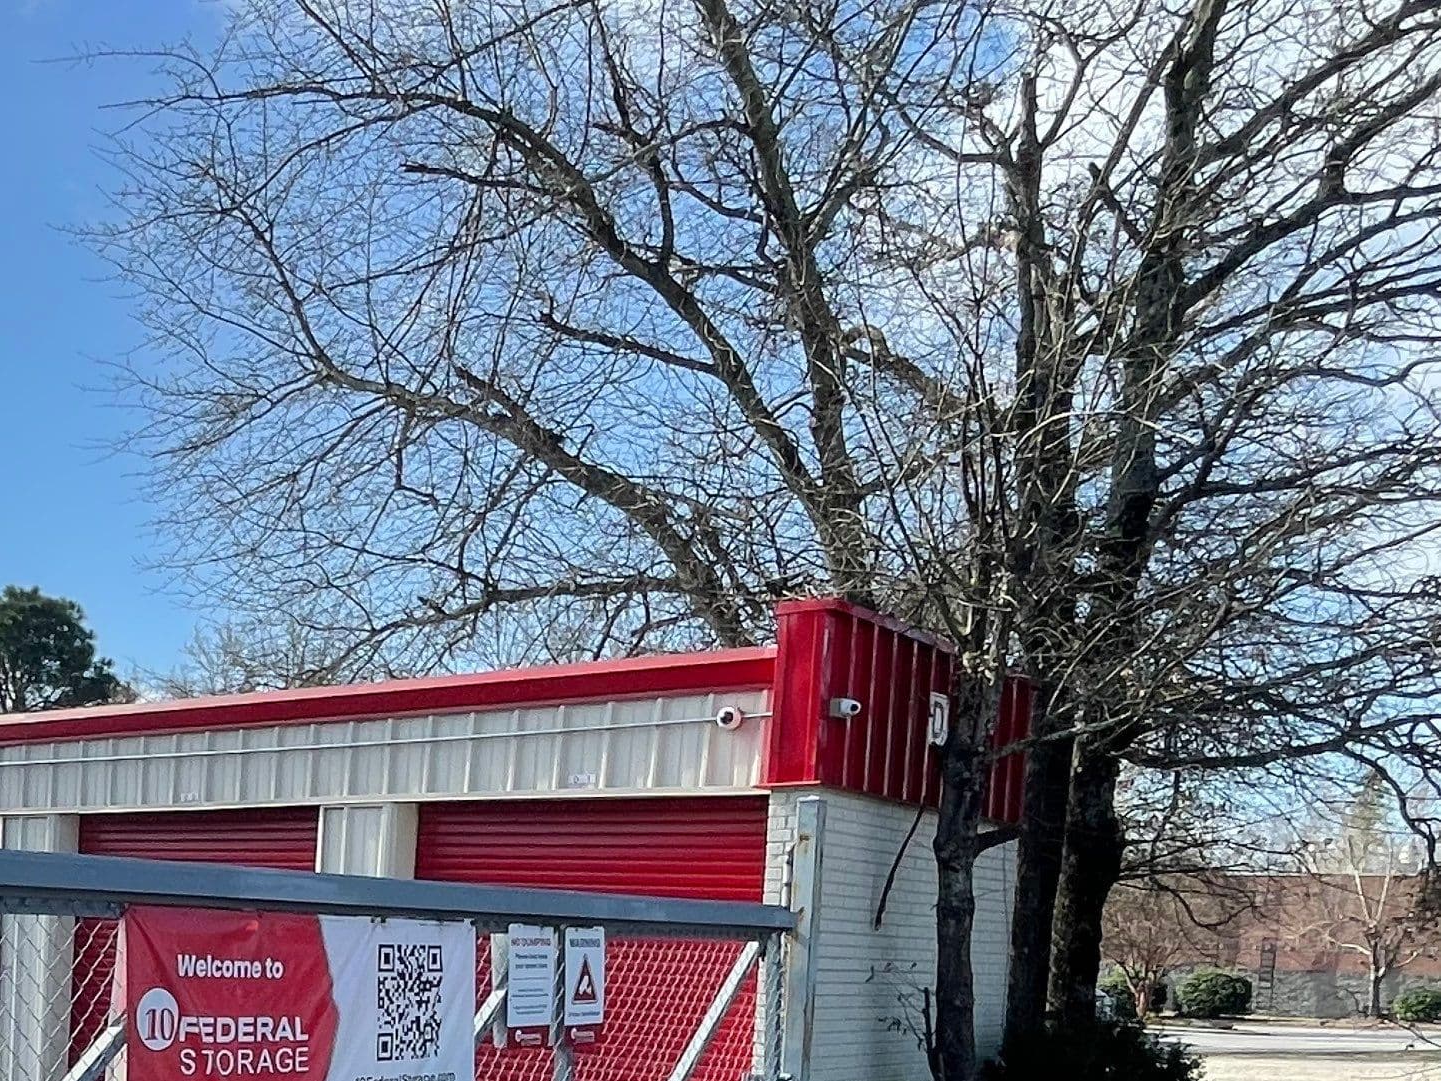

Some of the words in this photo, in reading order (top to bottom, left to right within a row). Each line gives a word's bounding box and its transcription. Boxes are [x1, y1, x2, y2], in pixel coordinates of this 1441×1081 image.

[177, 954, 262, 979] Welcome
[265, 957, 284, 980] to
[144, 1007, 176, 1041] 10
[179, 1015, 309, 1044] FEDERAL
[180, 1046, 310, 1076] STORAGE
